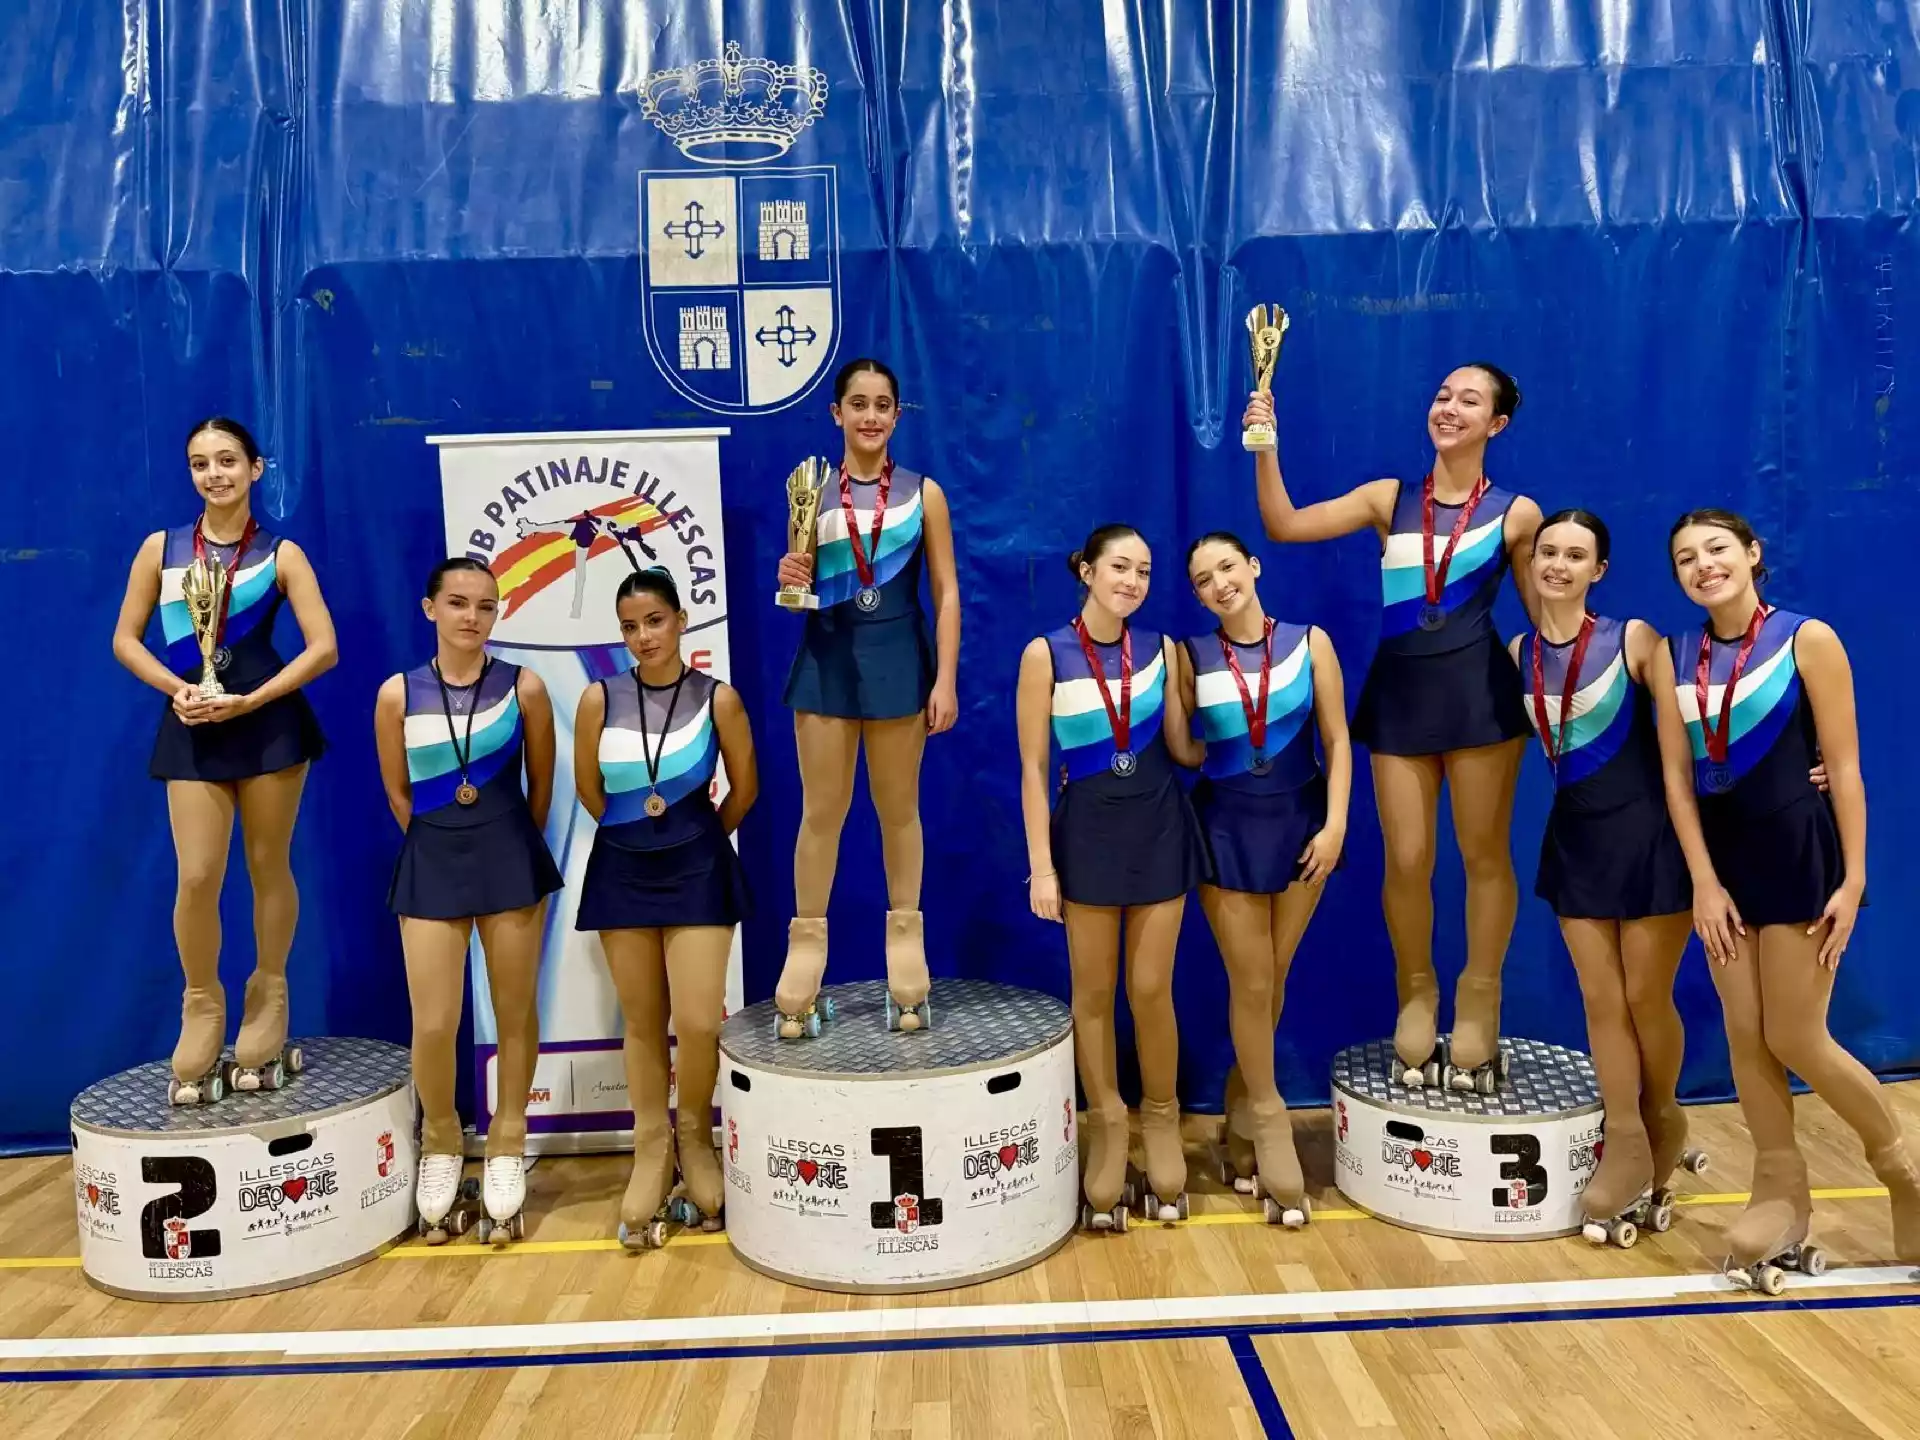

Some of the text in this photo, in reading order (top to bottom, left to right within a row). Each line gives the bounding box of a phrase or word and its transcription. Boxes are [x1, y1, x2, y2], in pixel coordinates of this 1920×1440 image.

[466, 456, 717, 606] UB PATINAJE ILLESCAS
[767, 1134, 846, 1158] ILLESCAS
[964, 1118, 1038, 1148] ILLESCAS
[239, 1152, 335, 1182] ILLESCAS
[870, 1126, 943, 1229] 1
[1490, 1133, 1548, 1207] 3
[141, 1156, 222, 1259] 2
[877, 1239, 939, 1255] ILLESCAS
[148, 1266, 213, 1279] ILLESCAS
